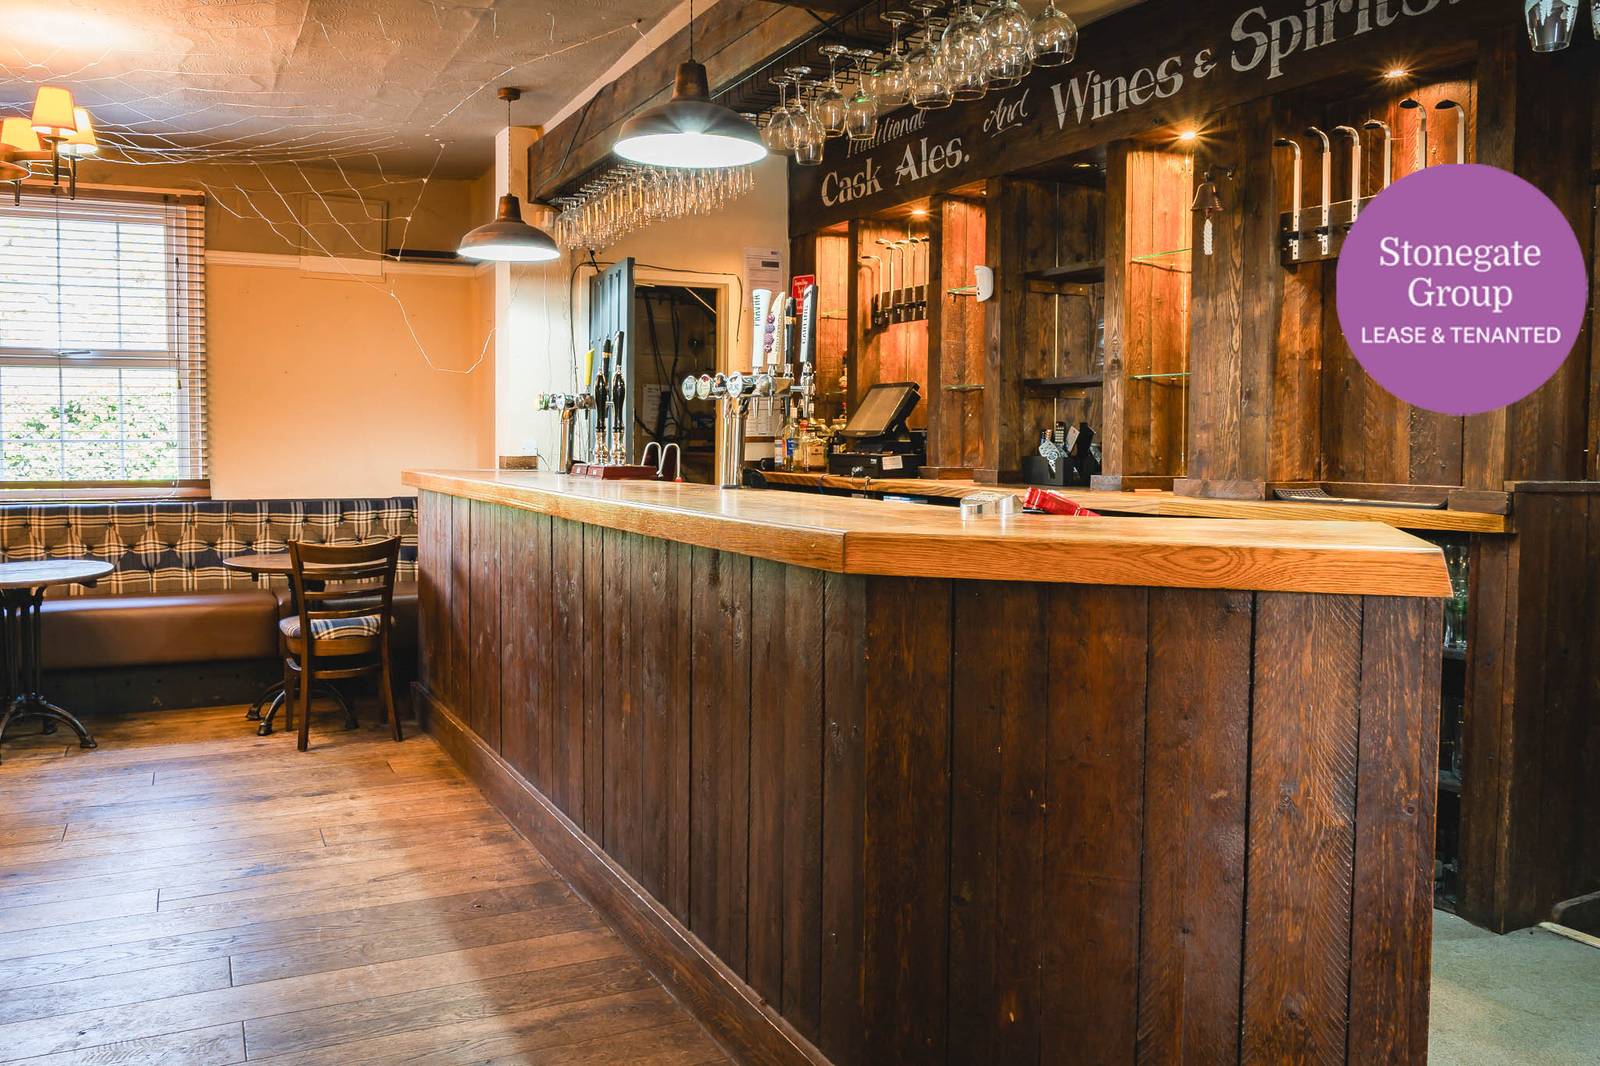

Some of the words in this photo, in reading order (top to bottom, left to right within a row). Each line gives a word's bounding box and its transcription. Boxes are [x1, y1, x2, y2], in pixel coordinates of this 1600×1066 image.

[821, 157, 883, 207] Cask
[895, 137, 970, 186] Ales.
[983, 87, 1029, 138] And
[1050, 55, 1184, 130] Wines
[1193, 49, 1217, 79] &
